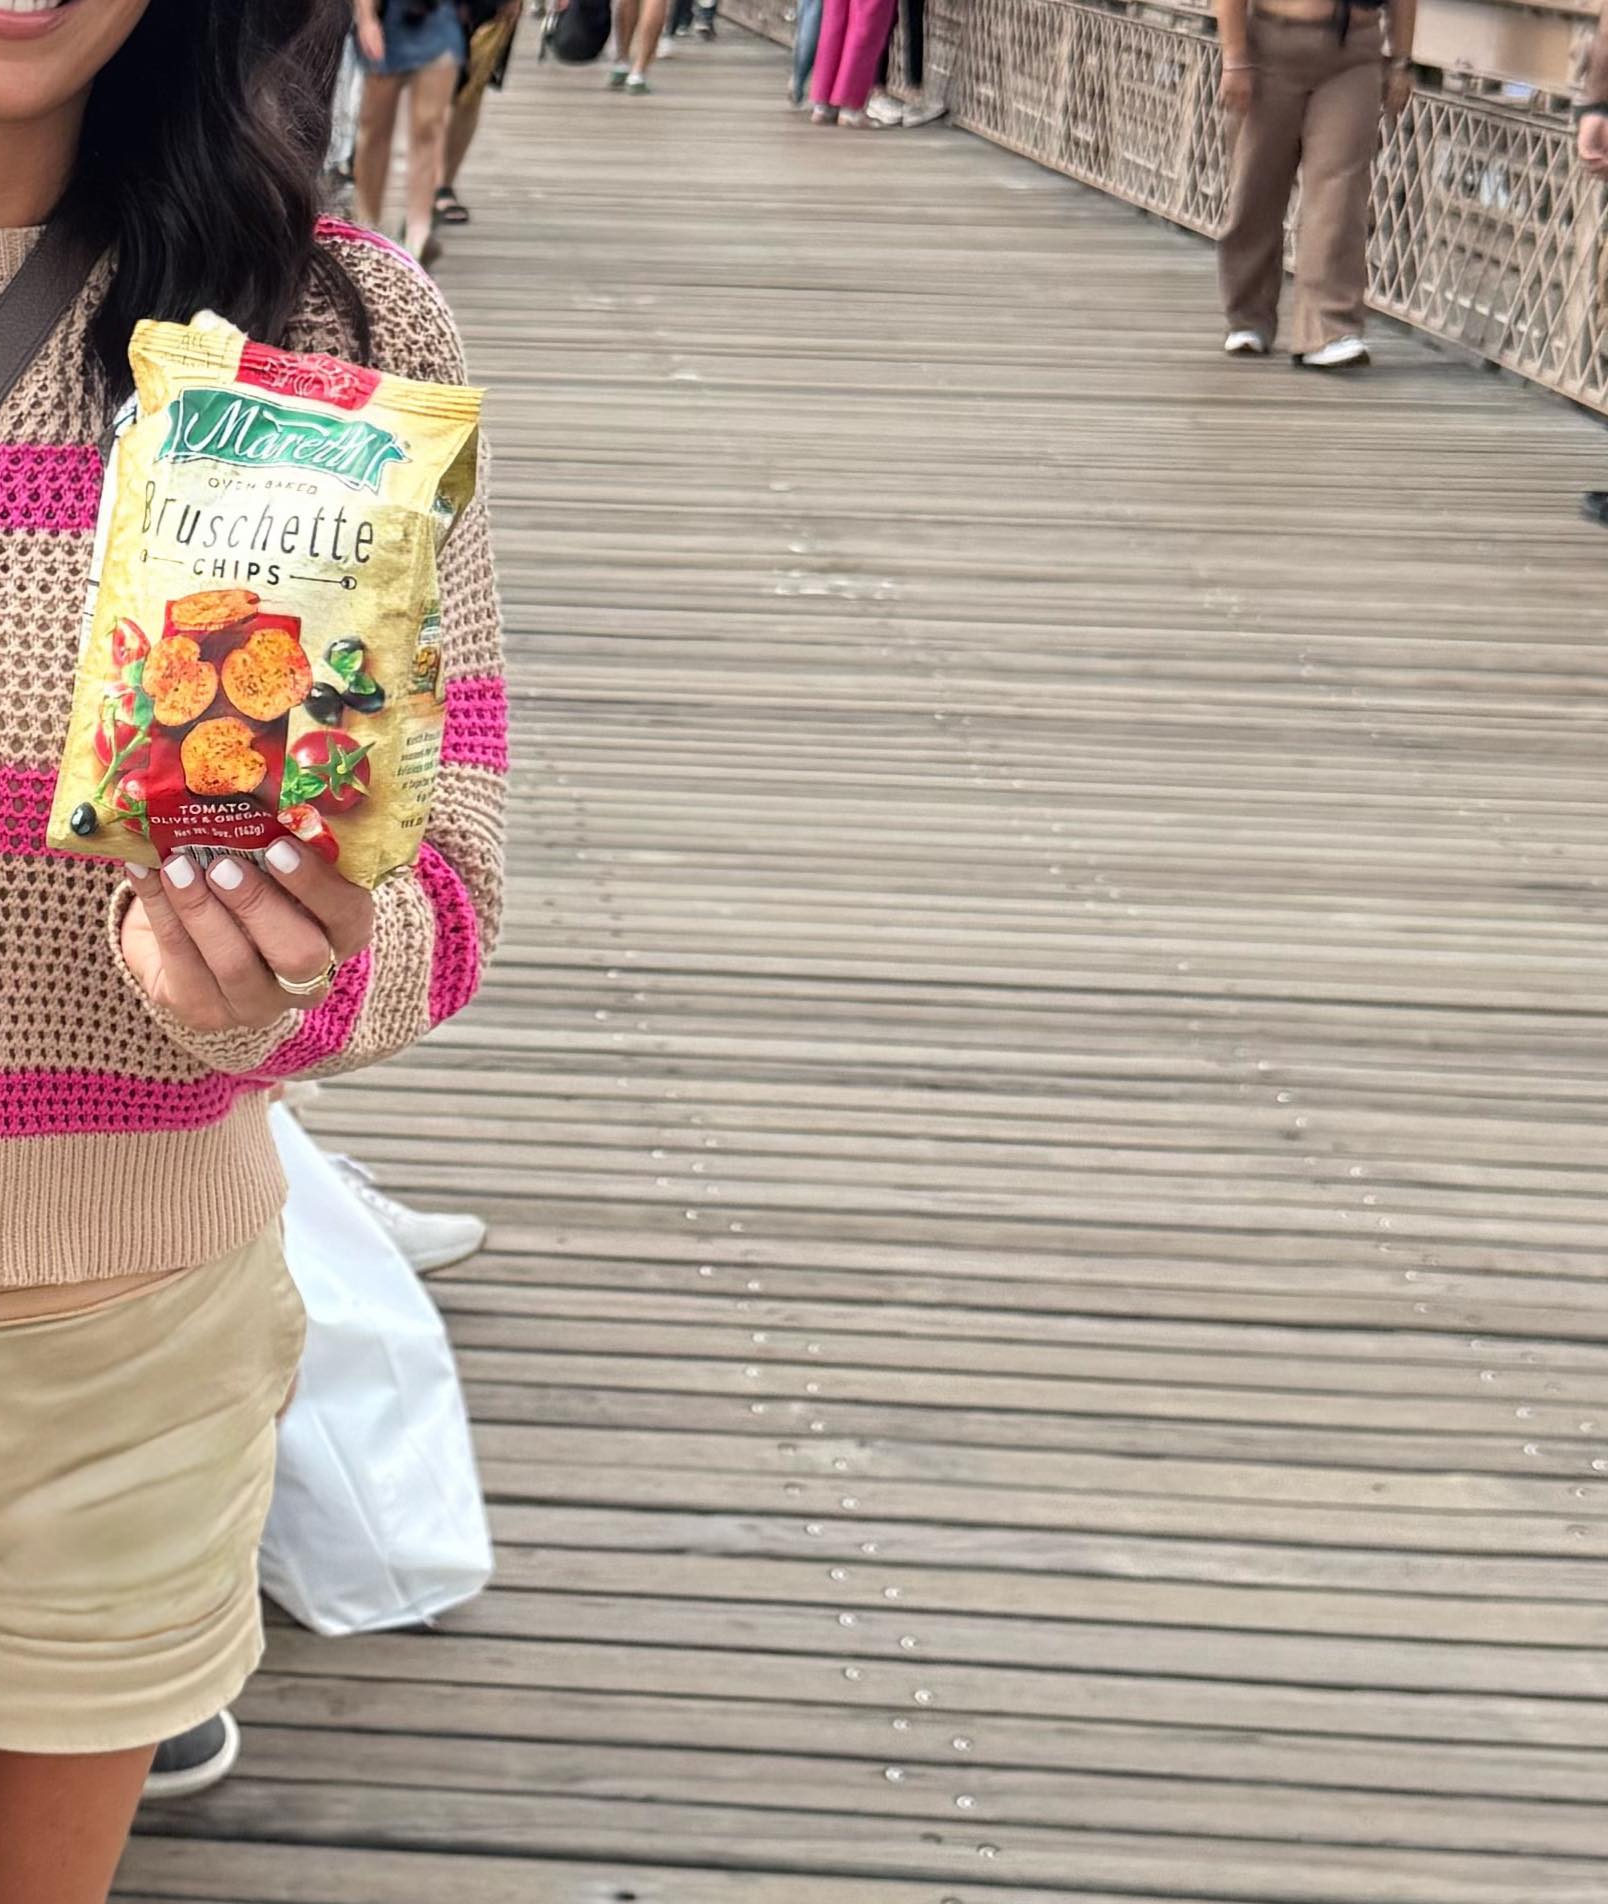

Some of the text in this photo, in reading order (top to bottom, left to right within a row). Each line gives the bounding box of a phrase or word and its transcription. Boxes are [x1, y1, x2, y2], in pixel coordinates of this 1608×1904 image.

[141, 480, 374, 563] Bruschette
[193, 558, 281, 585] CHIPS
[179, 802, 251, 815] TOMATO
[150, 816, 198, 825] OLIVES
